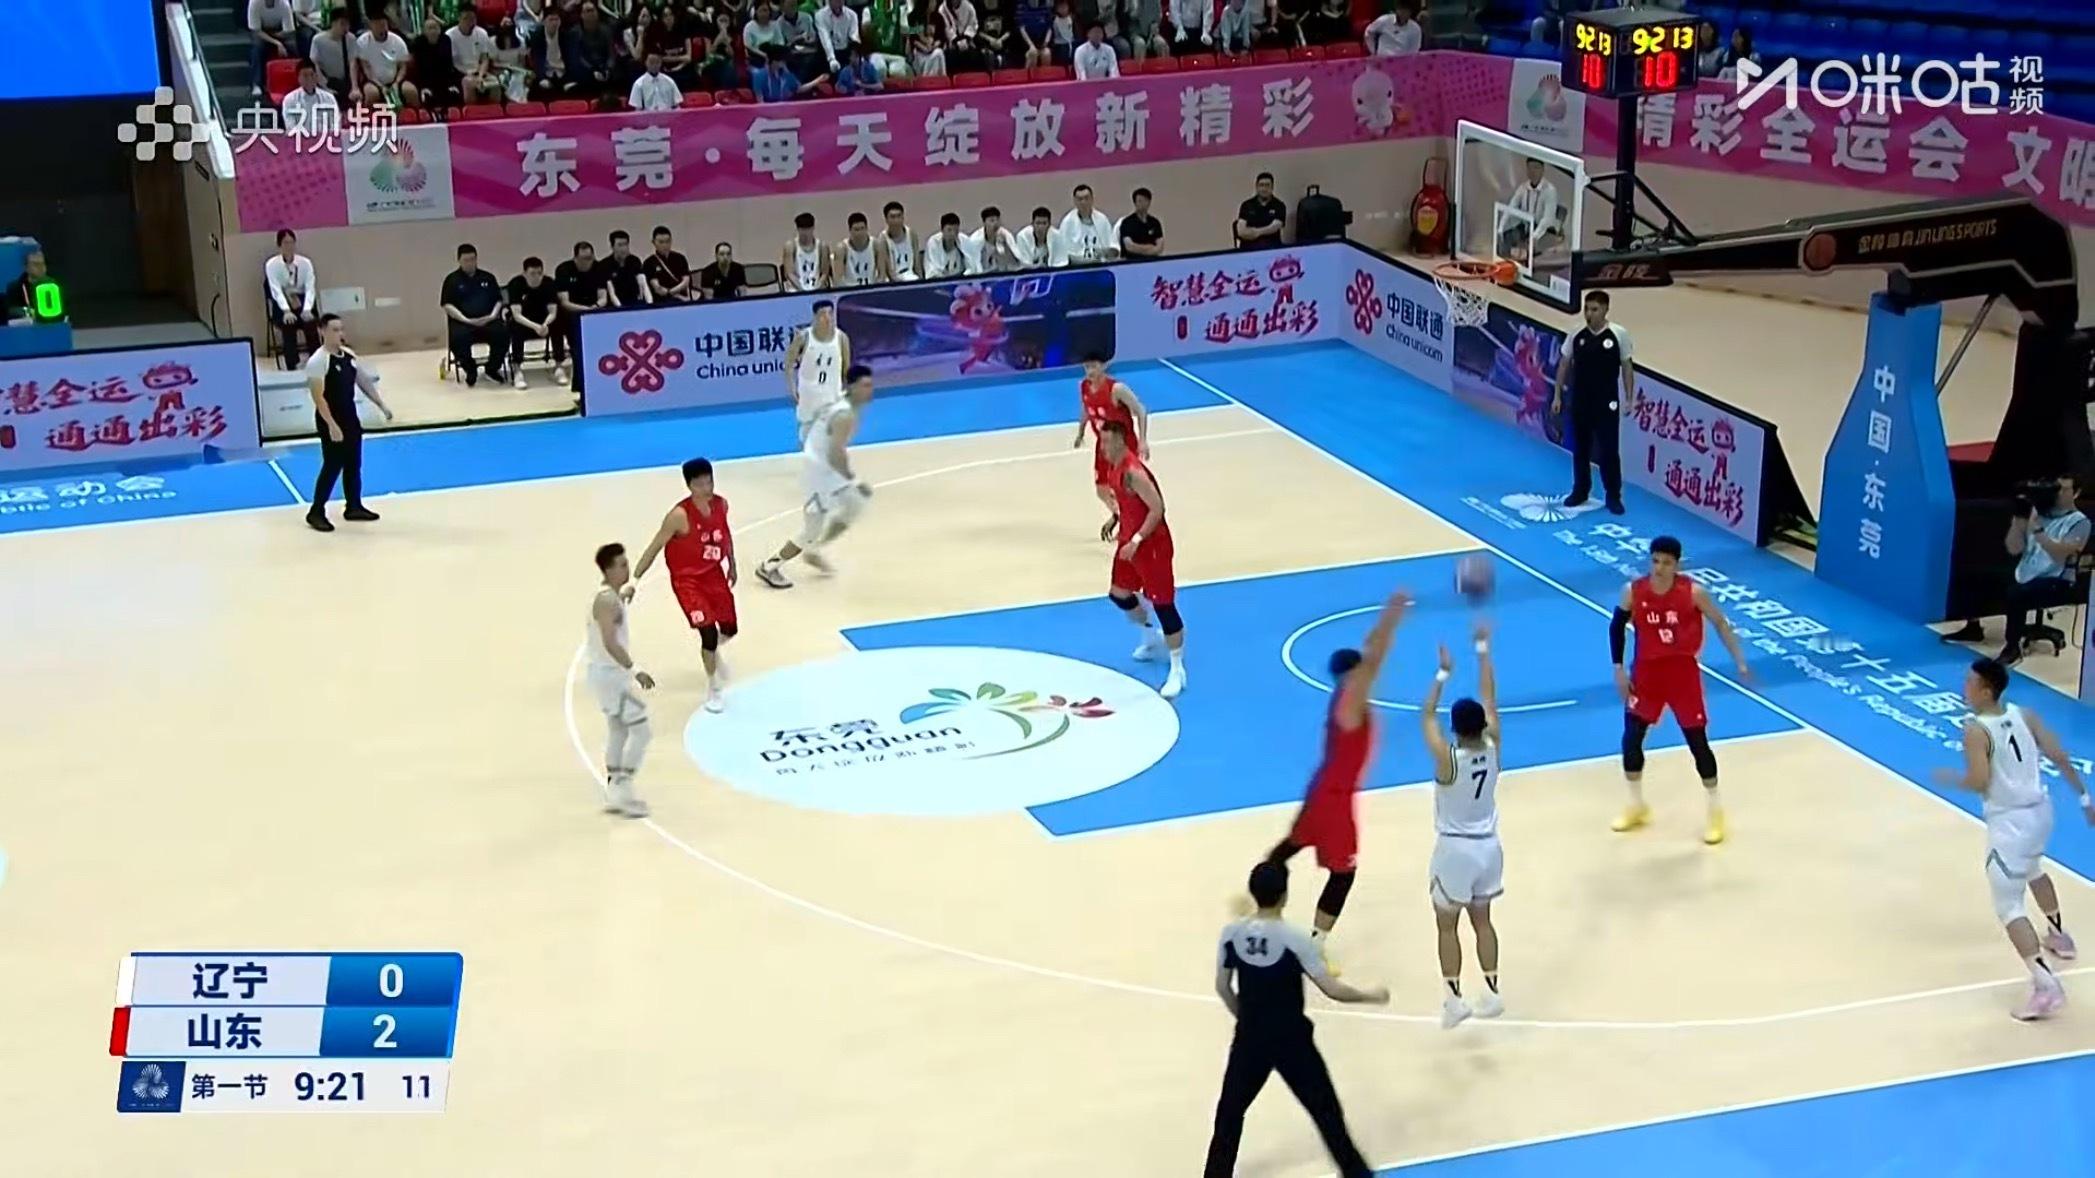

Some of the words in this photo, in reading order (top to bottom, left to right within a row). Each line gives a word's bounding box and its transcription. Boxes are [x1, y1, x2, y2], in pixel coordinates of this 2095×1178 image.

[1644, 51, 1676, 87] 10
[517, 76, 1314, 198] 东莞·每天绽放新精彩
[35, 282, 60, 318] 0
[1386, 292, 1444, 342] 中国联通
[695, 323, 811, 358] 中国联
[696, 359, 749, 380] China
[0, 376, 142, 416] 慧全运
[1858, 365, 1896, 559] 中国·东莞
[703, 545, 721, 560] 20
[760, 726, 962, 762] Dongguan
[2010, 734, 2022, 763] 1
[1471, 769, 1488, 800] 7
